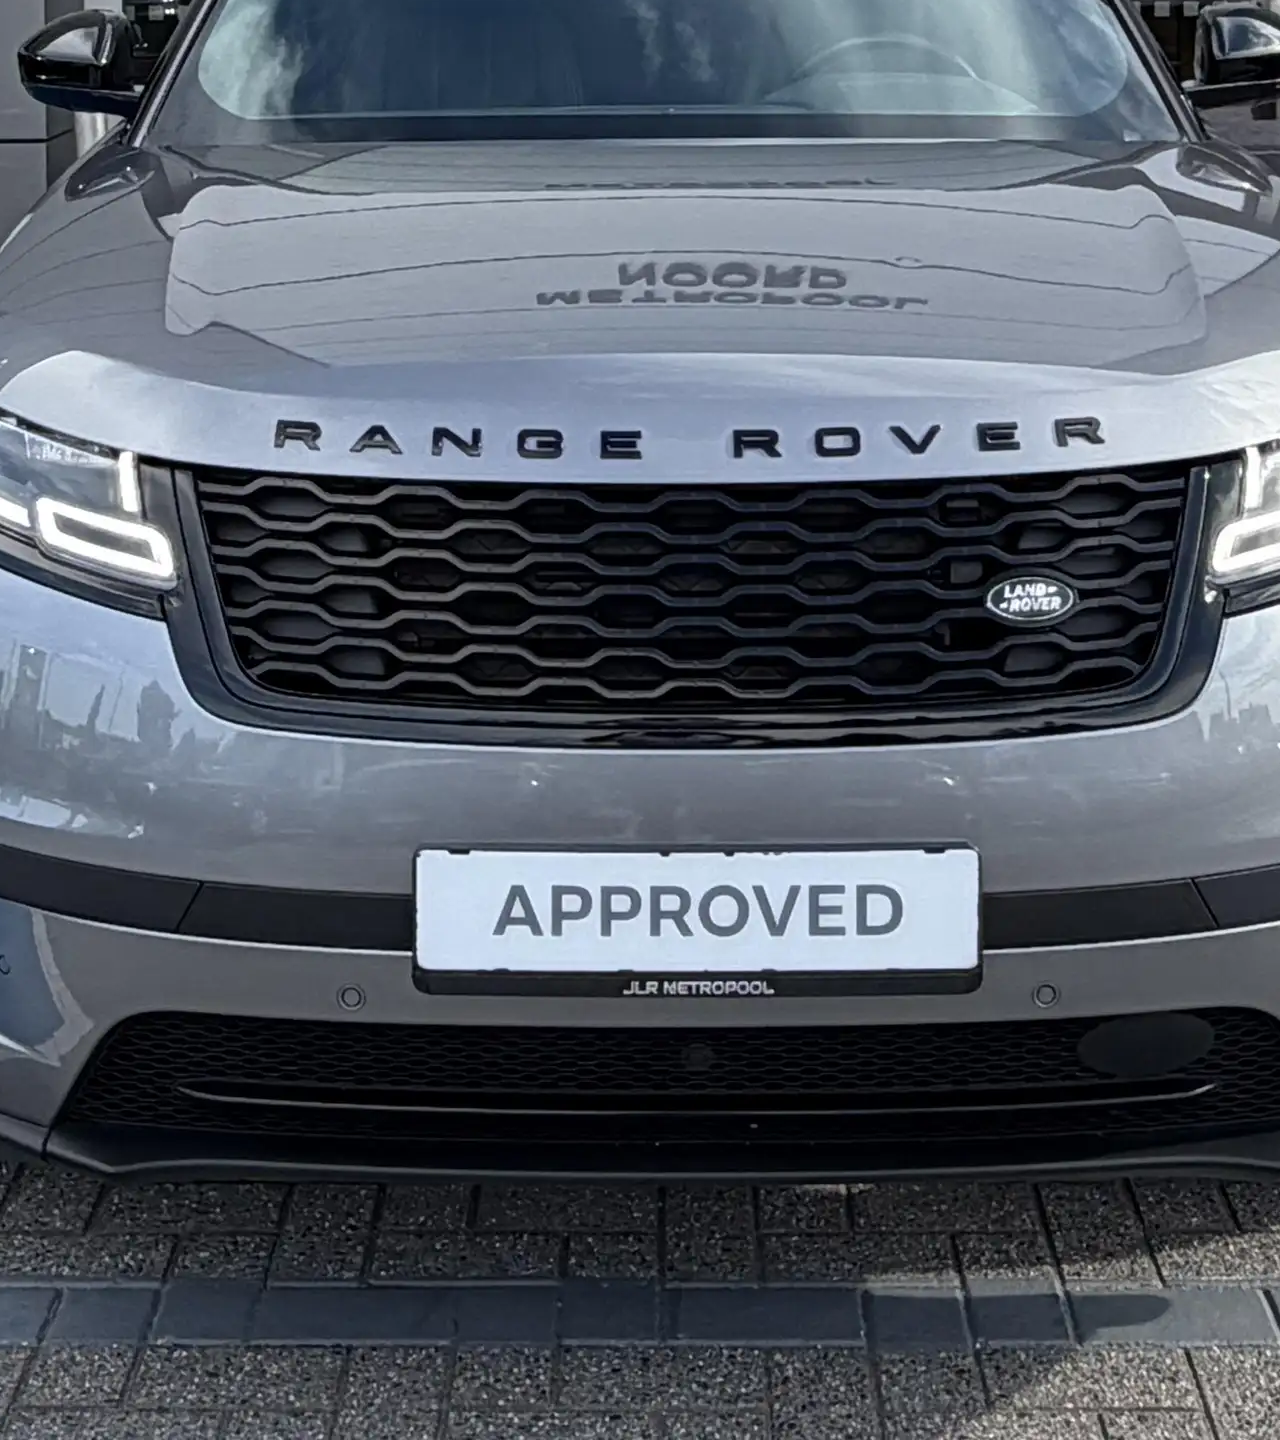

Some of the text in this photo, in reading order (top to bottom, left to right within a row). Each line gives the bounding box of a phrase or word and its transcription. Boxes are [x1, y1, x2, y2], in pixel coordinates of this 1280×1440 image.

[273, 416, 1106, 459] RANGE ROVER
[1003, 583, 1047, 598] LAND
[1009, 596, 1062, 612] ROVER
[493, 884, 904, 938] APPROVED
[623, 981, 775, 995] JLR METROPOOL
